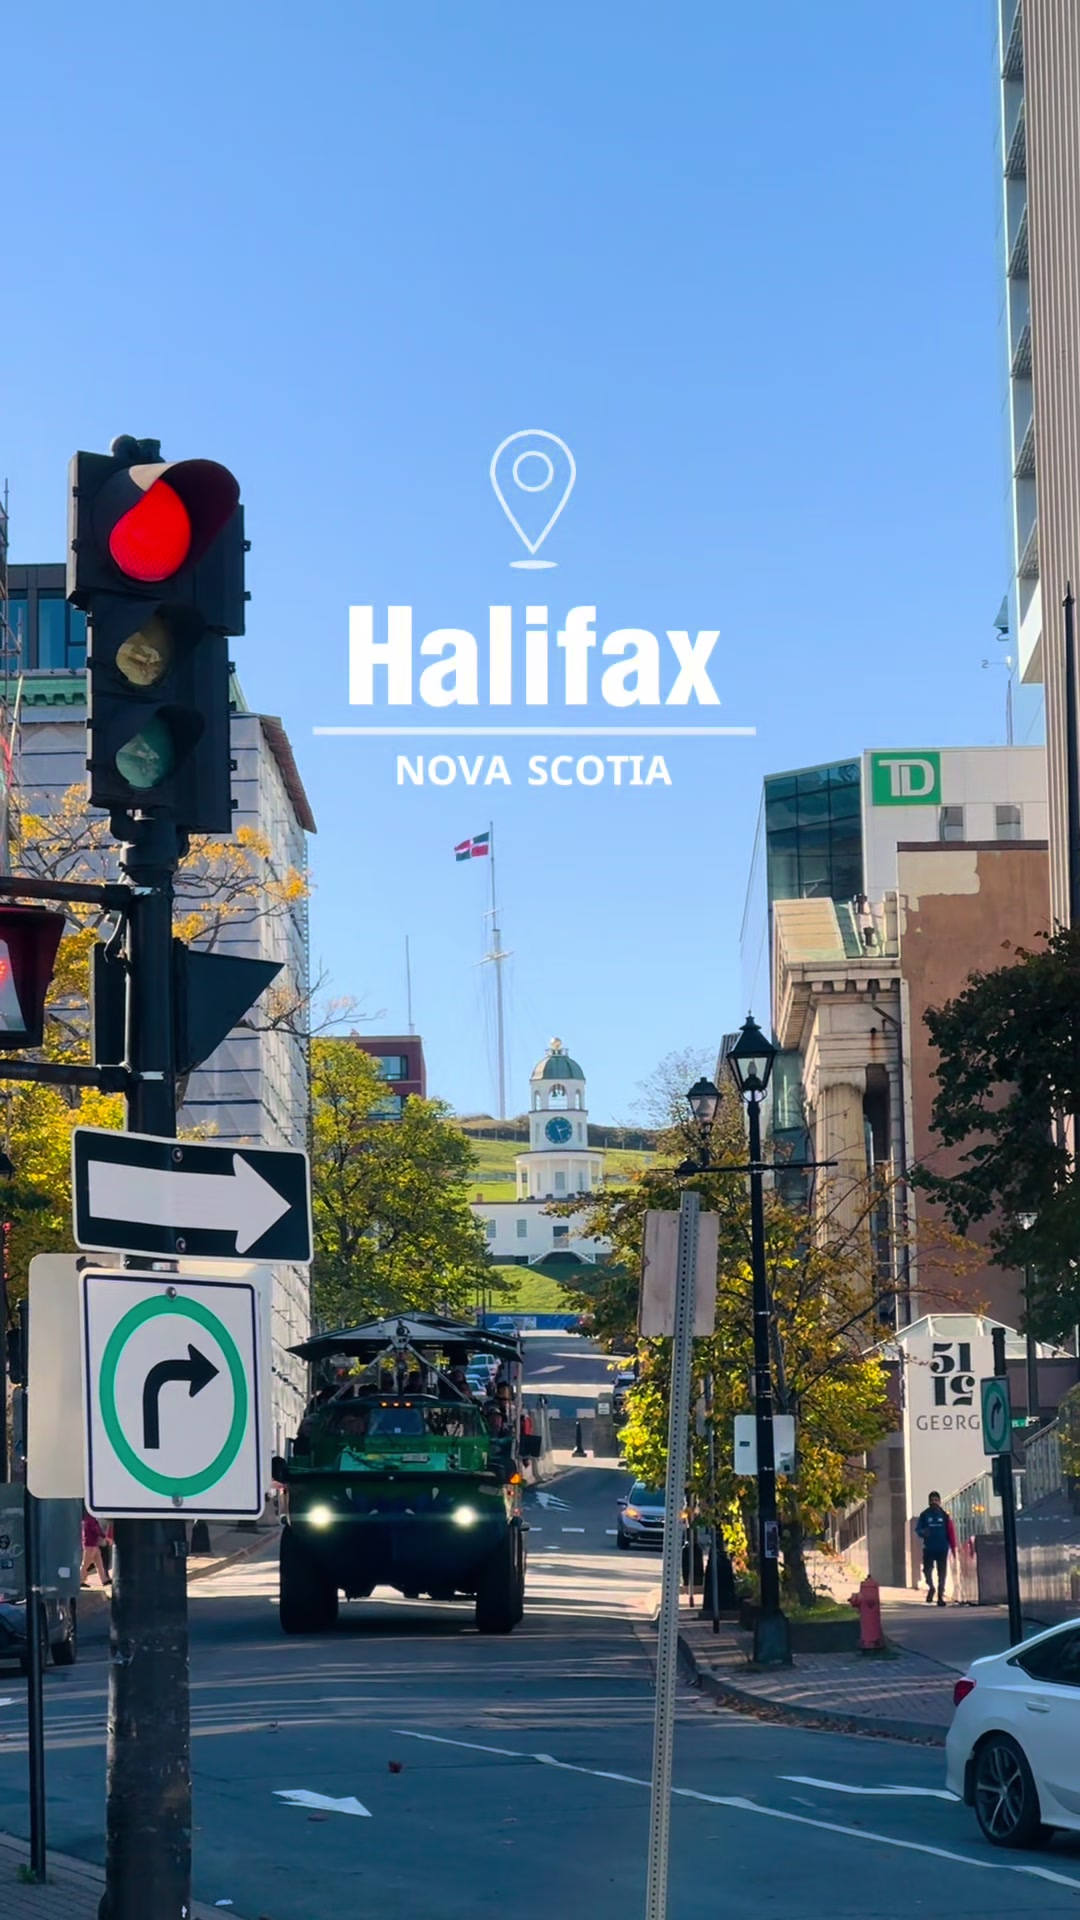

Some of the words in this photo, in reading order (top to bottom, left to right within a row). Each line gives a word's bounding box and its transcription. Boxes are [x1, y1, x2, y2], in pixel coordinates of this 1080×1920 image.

[879, 759, 935, 797] TD
[930, 1342, 974, 1374] 51
[916, 1414, 981, 1431] GEORG
